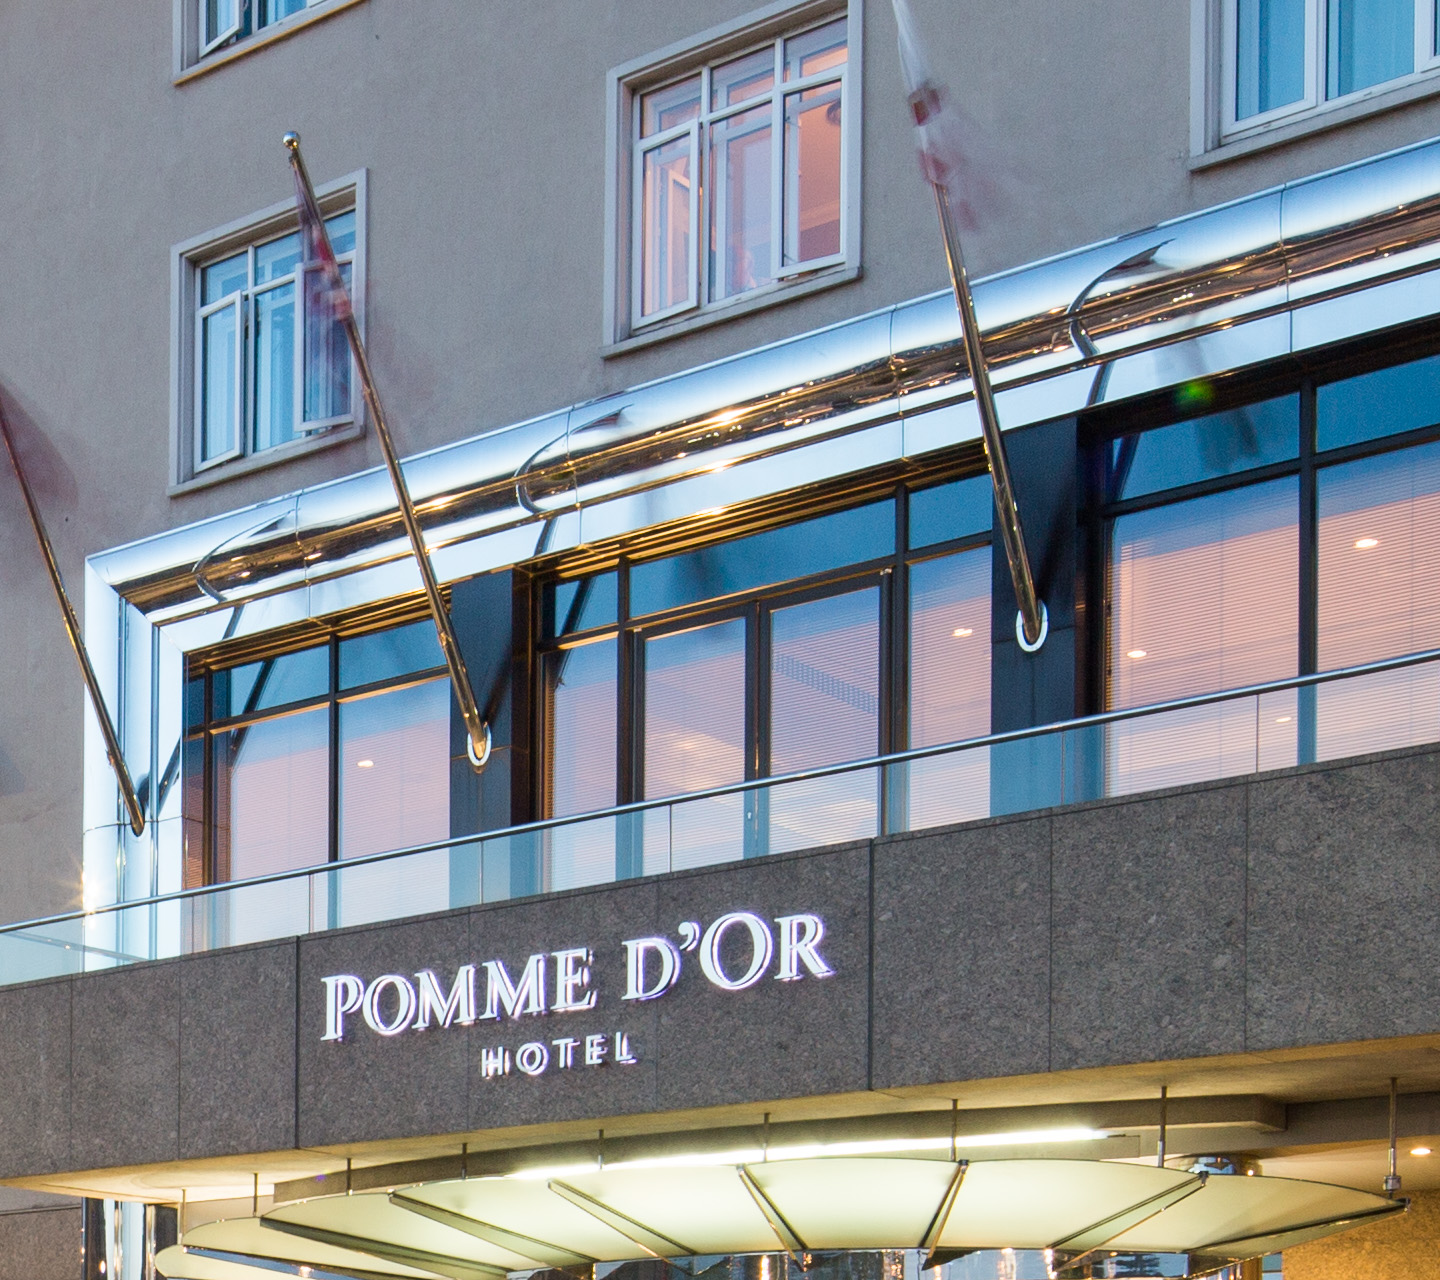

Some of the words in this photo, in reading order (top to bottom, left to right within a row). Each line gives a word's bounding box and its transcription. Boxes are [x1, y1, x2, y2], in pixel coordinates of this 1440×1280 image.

[319, 946, 597, 1042] POMME
[620, 911, 836, 1002] D'OR
[480, 1030, 638, 1079] HOTEL
